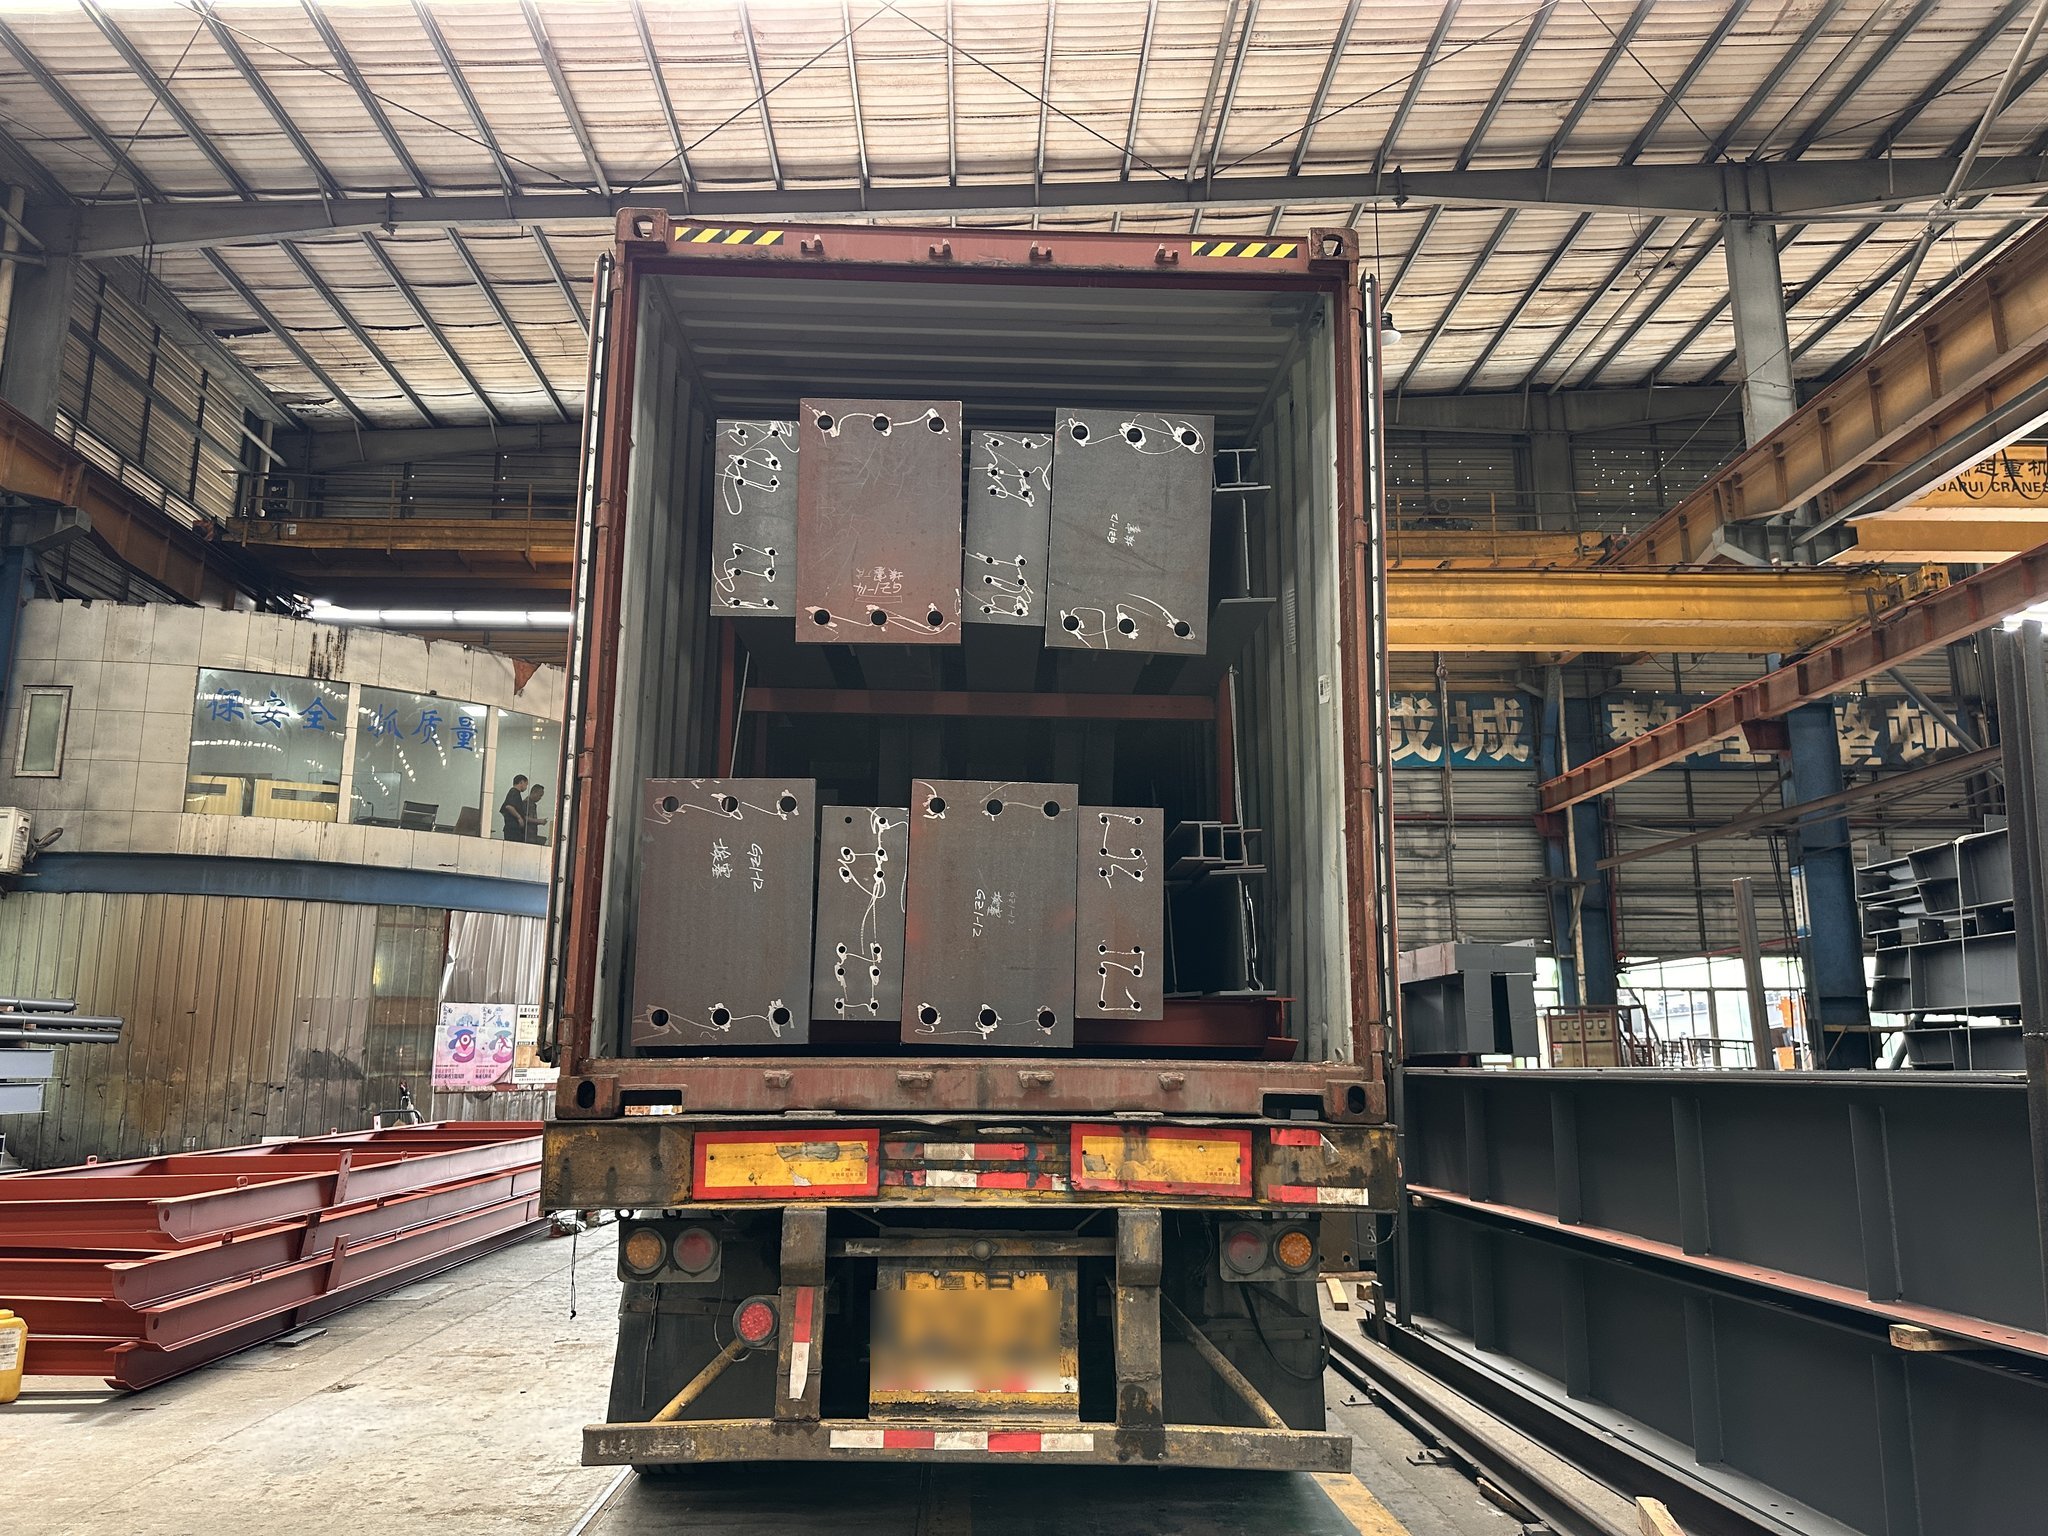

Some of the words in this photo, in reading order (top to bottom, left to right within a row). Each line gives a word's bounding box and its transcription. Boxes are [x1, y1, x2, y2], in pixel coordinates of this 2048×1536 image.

[1960, 459, 2048, 478] 起重机
[206, 688, 337, 732] 保安全
[367, 703, 479, 751] 抓质量
